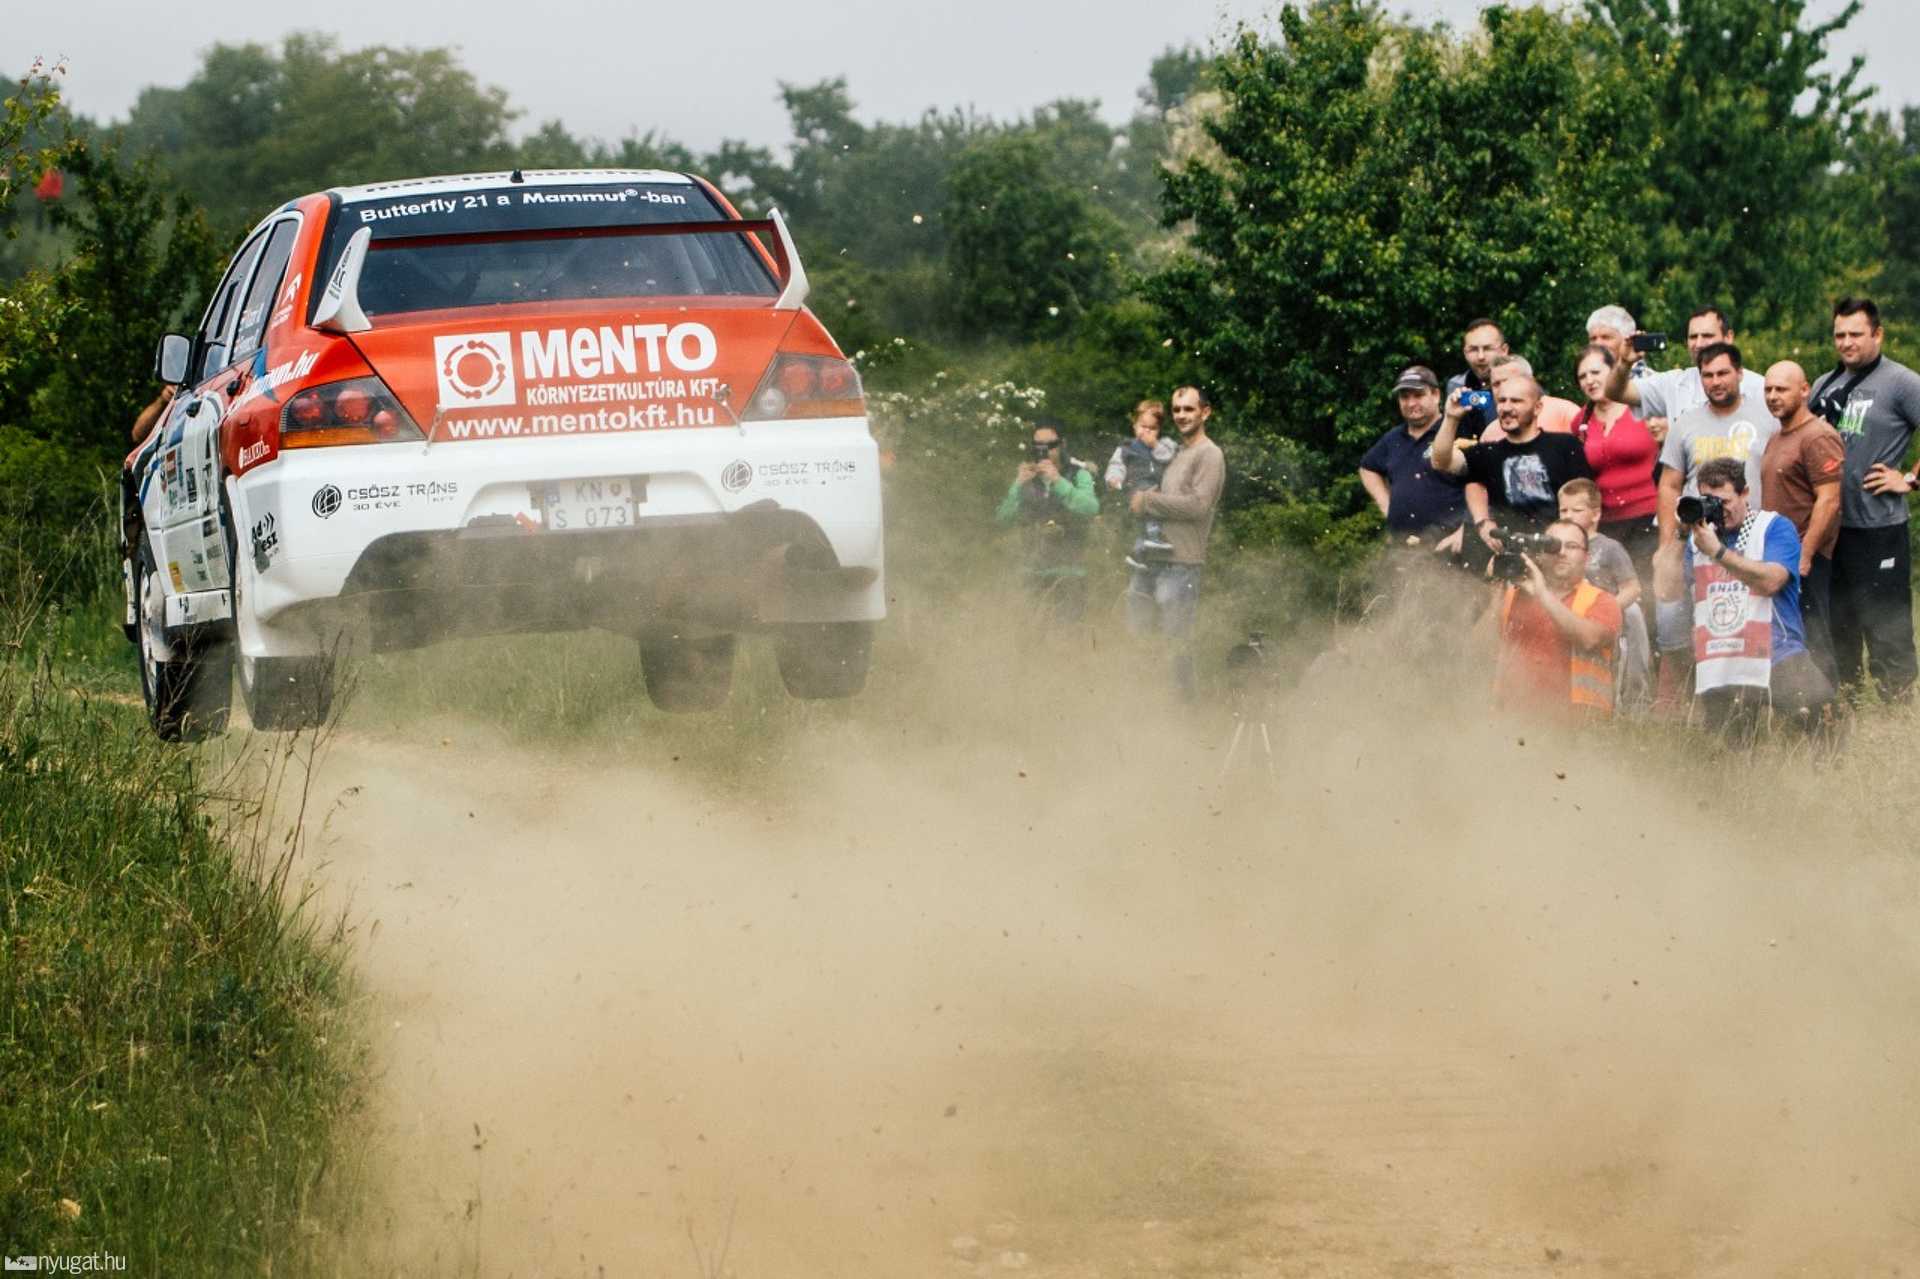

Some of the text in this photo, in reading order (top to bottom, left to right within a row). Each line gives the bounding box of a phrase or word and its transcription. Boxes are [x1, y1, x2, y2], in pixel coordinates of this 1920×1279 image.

[360, 198, 456, 222] Butterfly
[464, 194, 488, 209] 21
[497, 195, 511, 206] a
[526, 376, 685, 406] KÖRNYEZETKULTÚRA
[448, 403, 715, 439] www.mentokft.hu
[555, 505, 627, 529] S 073
